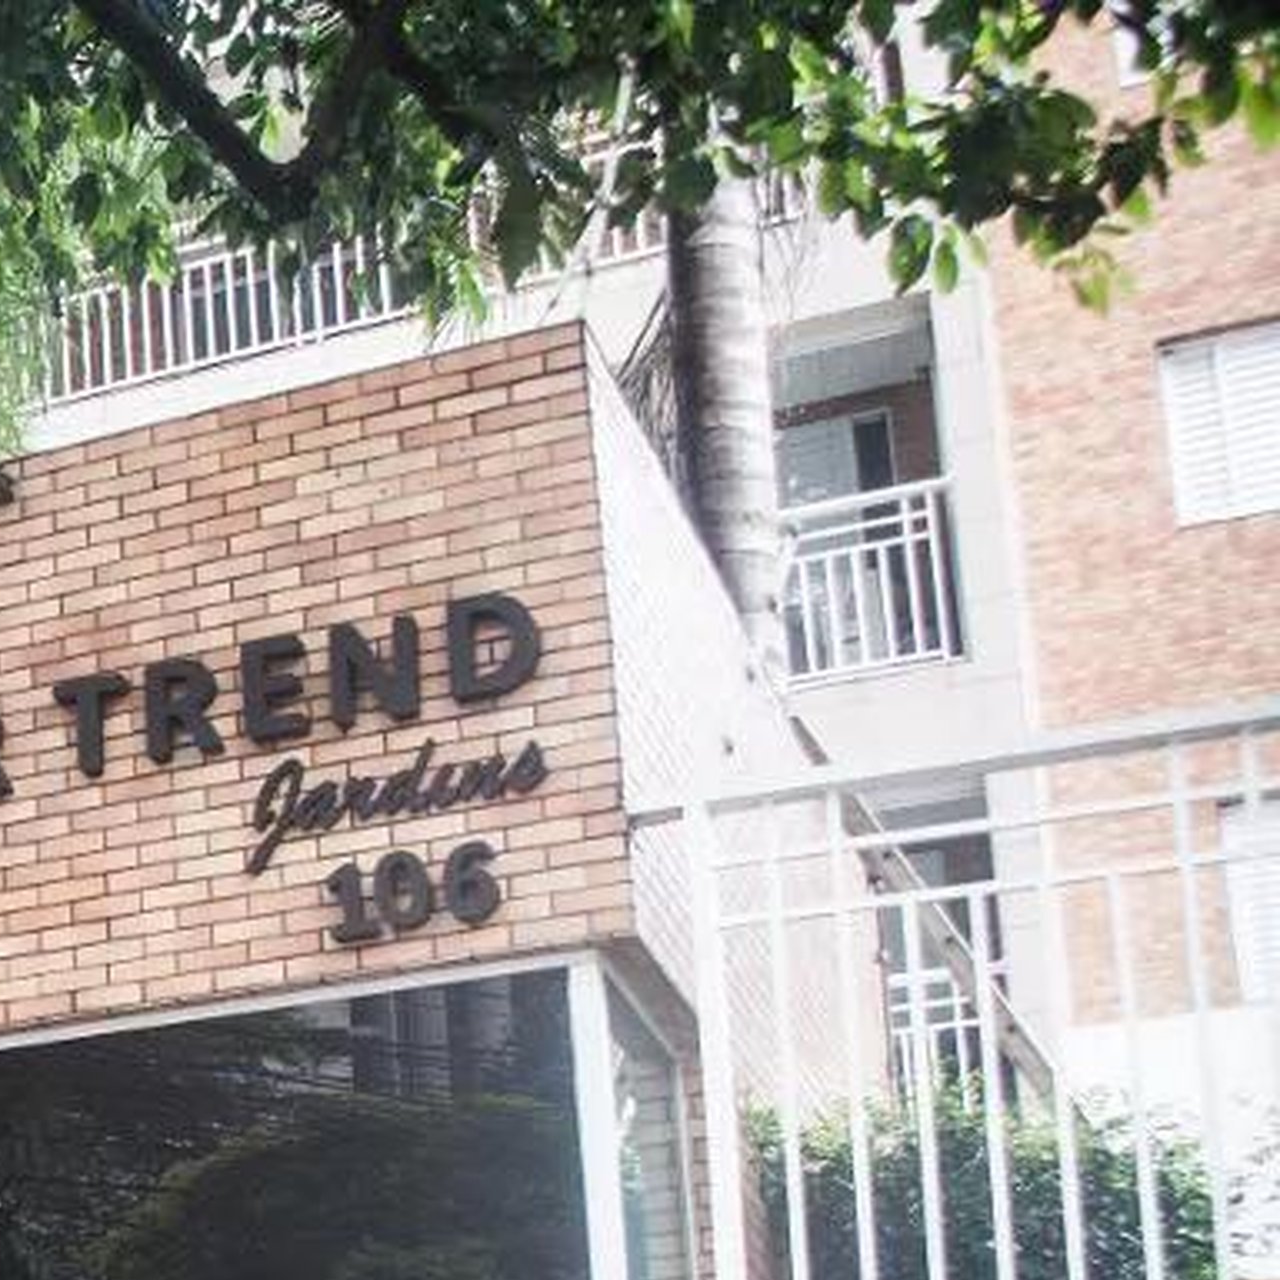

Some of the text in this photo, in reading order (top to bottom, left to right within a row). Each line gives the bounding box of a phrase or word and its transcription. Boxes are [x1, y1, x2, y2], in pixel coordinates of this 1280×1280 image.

[52, 593, 542, 779] TREND
[245, 737, 550, 875] Jardins
[326, 840, 502, 944] 106
